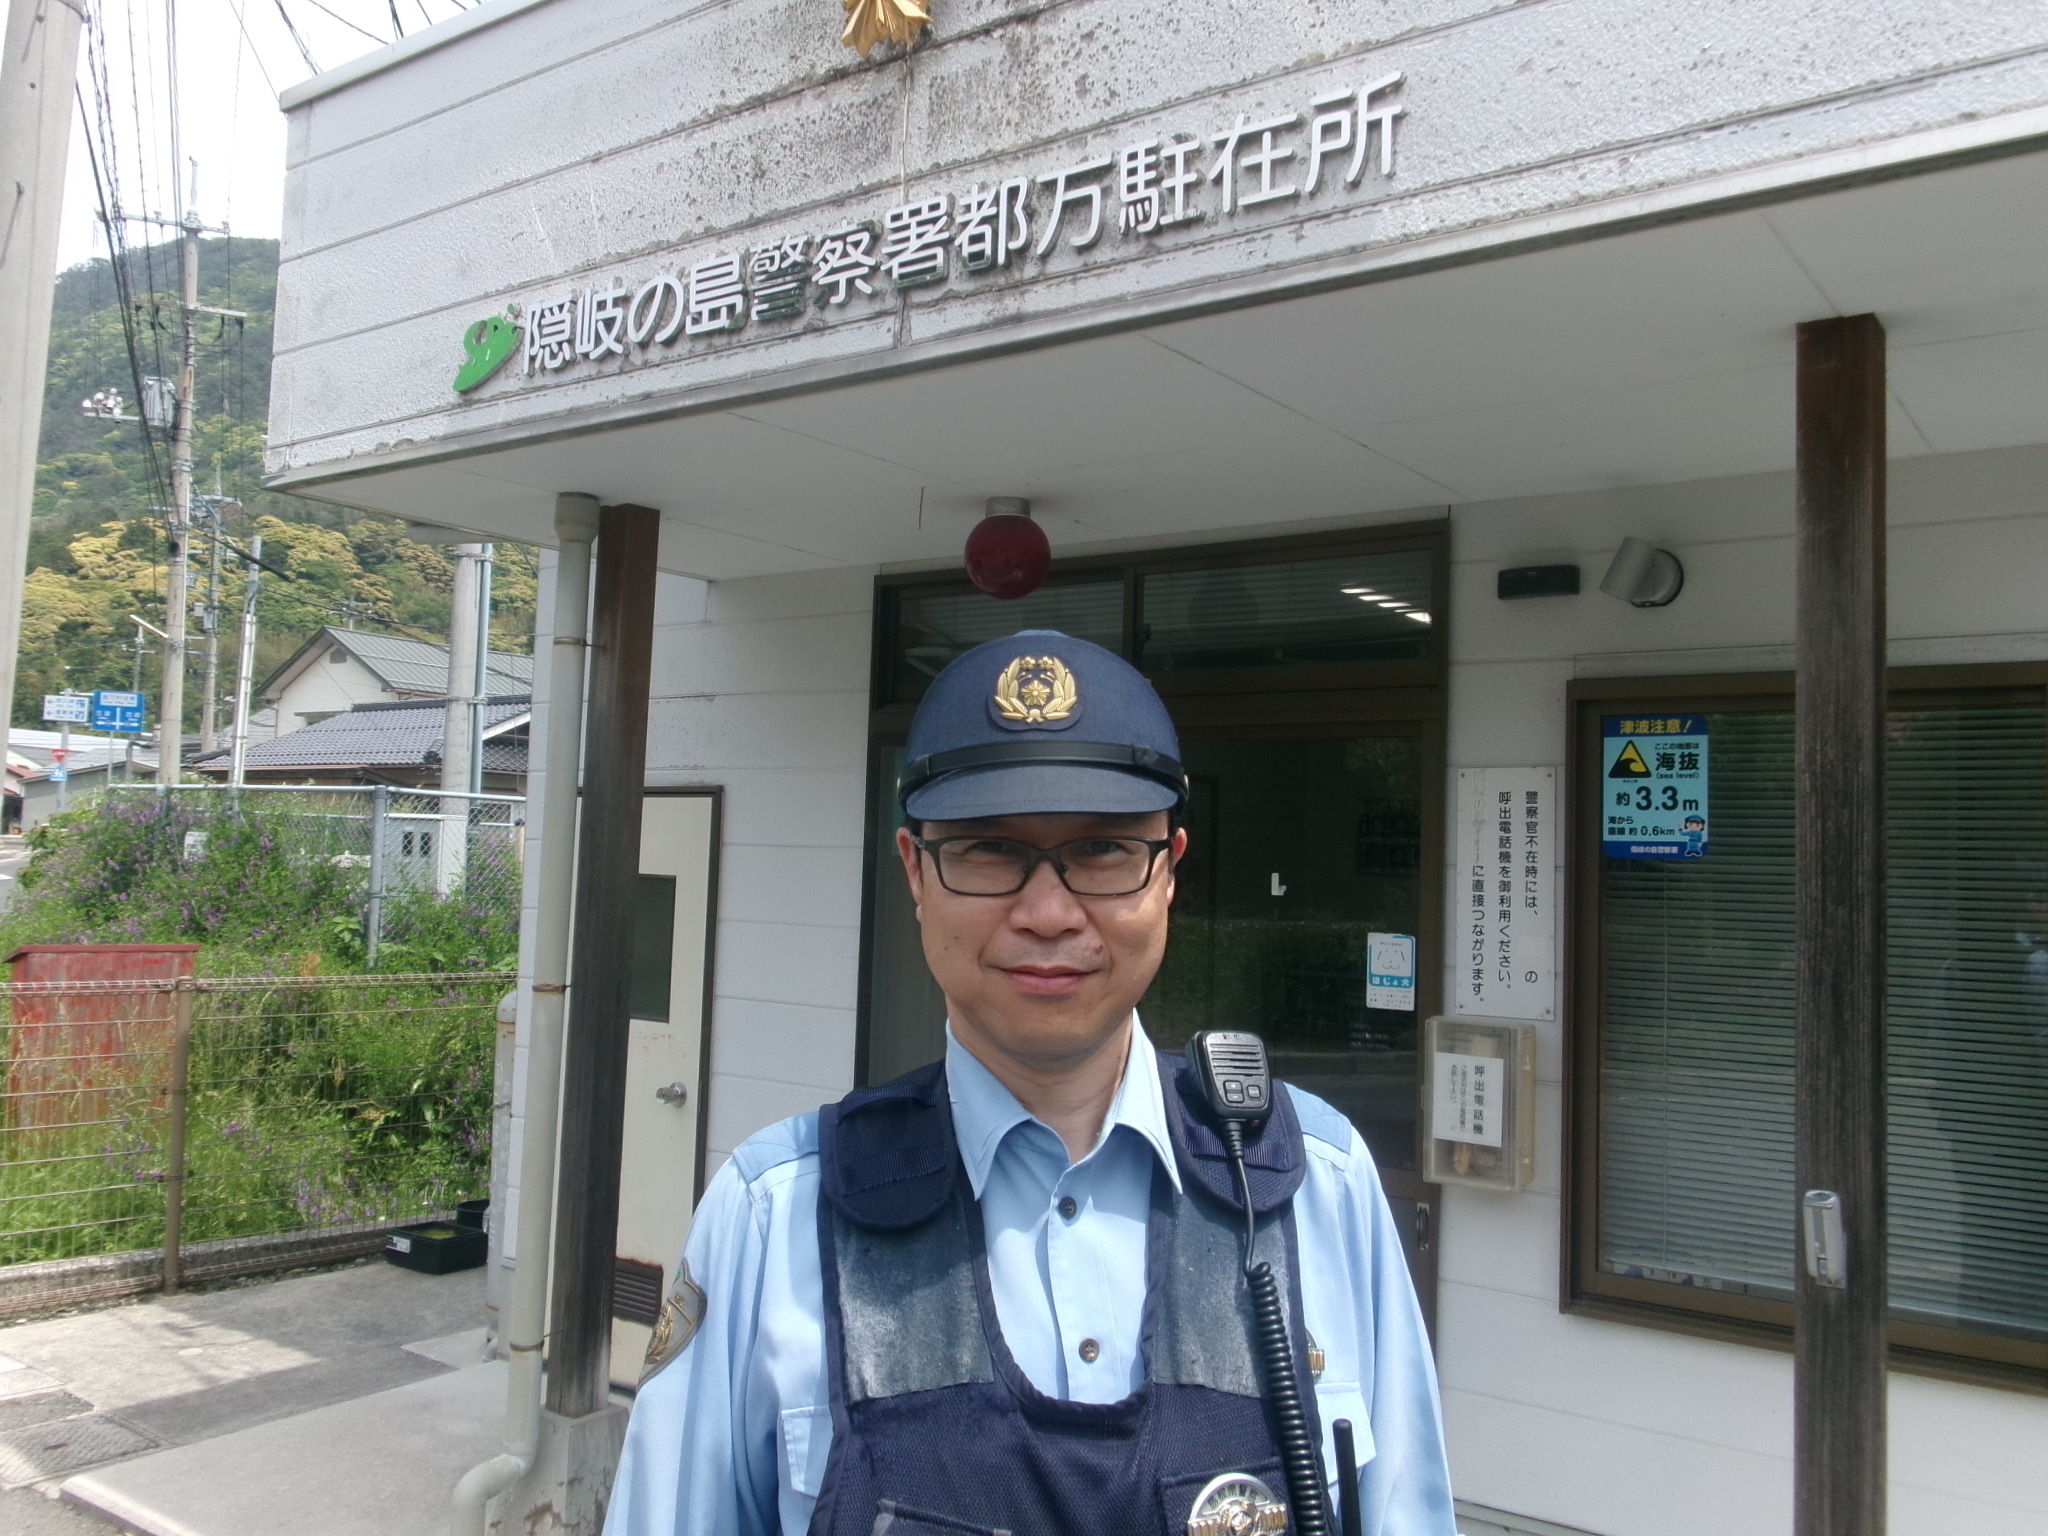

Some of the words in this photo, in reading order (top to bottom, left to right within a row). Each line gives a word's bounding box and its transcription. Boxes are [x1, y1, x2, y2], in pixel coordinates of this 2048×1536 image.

[520, 69, 1404, 376] 隠岐の島警察署都万駐在所
[1655, 752, 1700, 771] 海抜
[1525, 790, 1538, 916] 警察官不在時には、
[1607, 816, 1634, 825] 海から
[1498, 791, 1512, 990] 呼出電話機を御利用ください。
[1473, 1065, 1485, 1136] 呼出電話機
